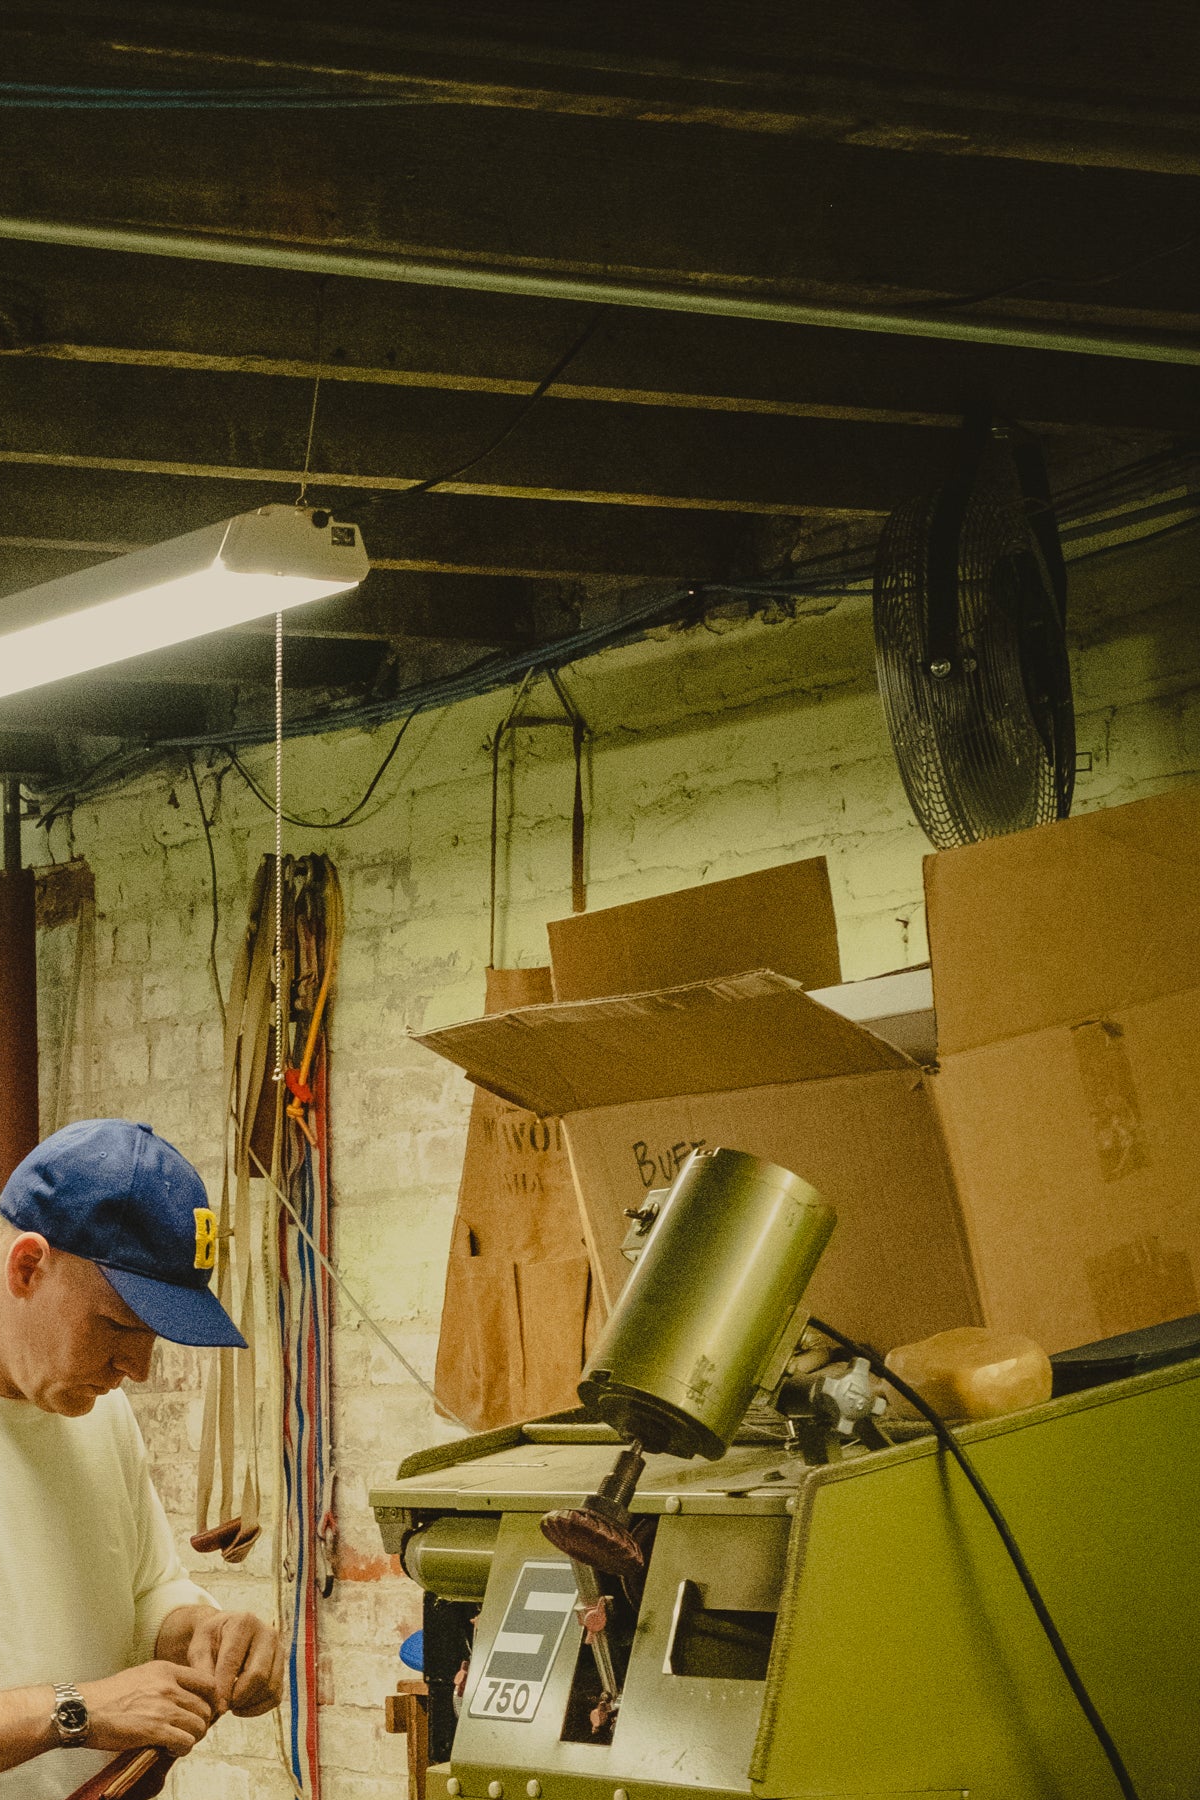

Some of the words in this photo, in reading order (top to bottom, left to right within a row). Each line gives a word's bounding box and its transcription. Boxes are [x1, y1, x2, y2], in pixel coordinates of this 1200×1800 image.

[633, 1138, 706, 1187] BUF
[193, 1208, 217, 1269] B
[482, 1680, 530, 1715] 750
